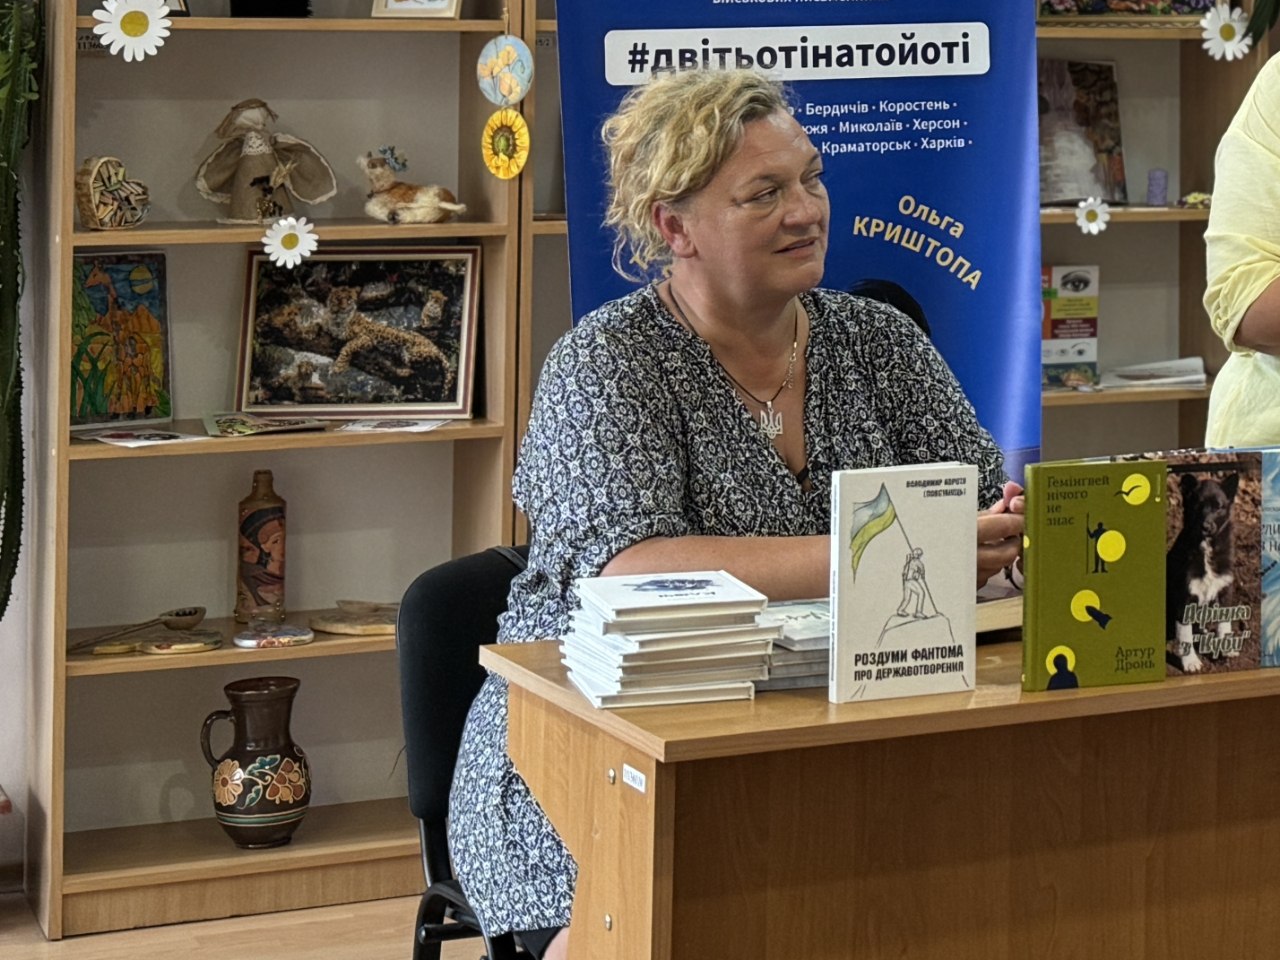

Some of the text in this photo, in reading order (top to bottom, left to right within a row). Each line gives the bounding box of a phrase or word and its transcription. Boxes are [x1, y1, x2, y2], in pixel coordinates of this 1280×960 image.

[806, 101, 869, 117] Бердичів
[879, 100, 950, 114] Коростень
[839, 118, 903, 133] Миколаїв
[912, 119, 961, 130] Херсон
[822, 136, 965, 156] Краматорськ Харків
[898, 195, 965, 239] Ольга
[853, 216, 983, 290] КРИШТОПА
[1047, 490, 1088, 501] нічого
[1047, 504, 1062, 513] не
[1183, 603, 1251, 629] Афінка
[854, 644, 964, 666] РОЗДУМИ ФАНТОМА
[1115, 646, 1155, 660] Артур
[1115, 658, 1155, 673] Дронь
[854, 670, 872, 681] ПРО
